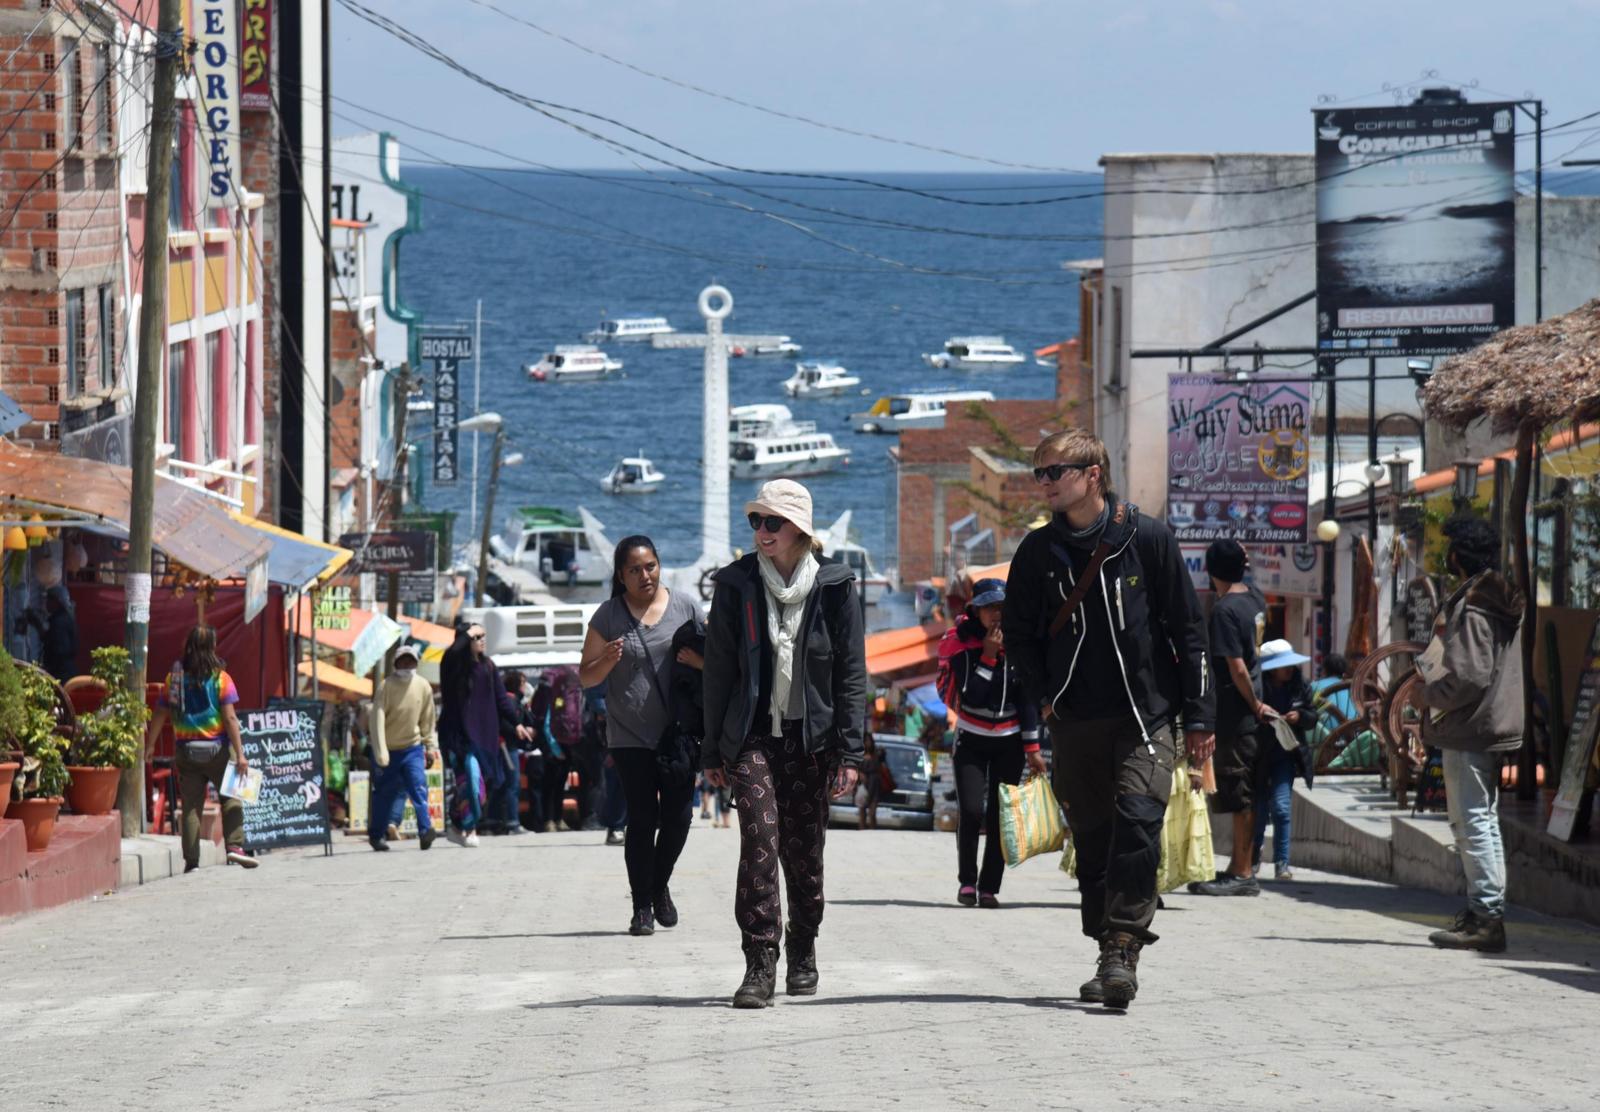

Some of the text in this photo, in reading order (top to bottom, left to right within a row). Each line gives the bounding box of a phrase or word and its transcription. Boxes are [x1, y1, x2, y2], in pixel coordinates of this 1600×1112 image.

[203, 0, 230, 197] EORGES
[1354, 117, 1479, 131] COFFEE SHOP
[1344, 305, 1486, 324] RESTAURANT
[1332, 329, 1346, 337] Un
[1347, 328, 1373, 337] lugar
[1422, 326, 1445, 335] Your
[1446, 326, 1466, 334] best
[1467, 325, 1499, 333] choice
[422, 339, 471, 357] HOSTAL
[436, 359, 455, 399] LAS
[436, 402, 456, 480] BRISAS
[313, 600, 352, 615] SOLES
[313, 615, 350, 630] EURO
[261, 738, 315, 753] Verduras
